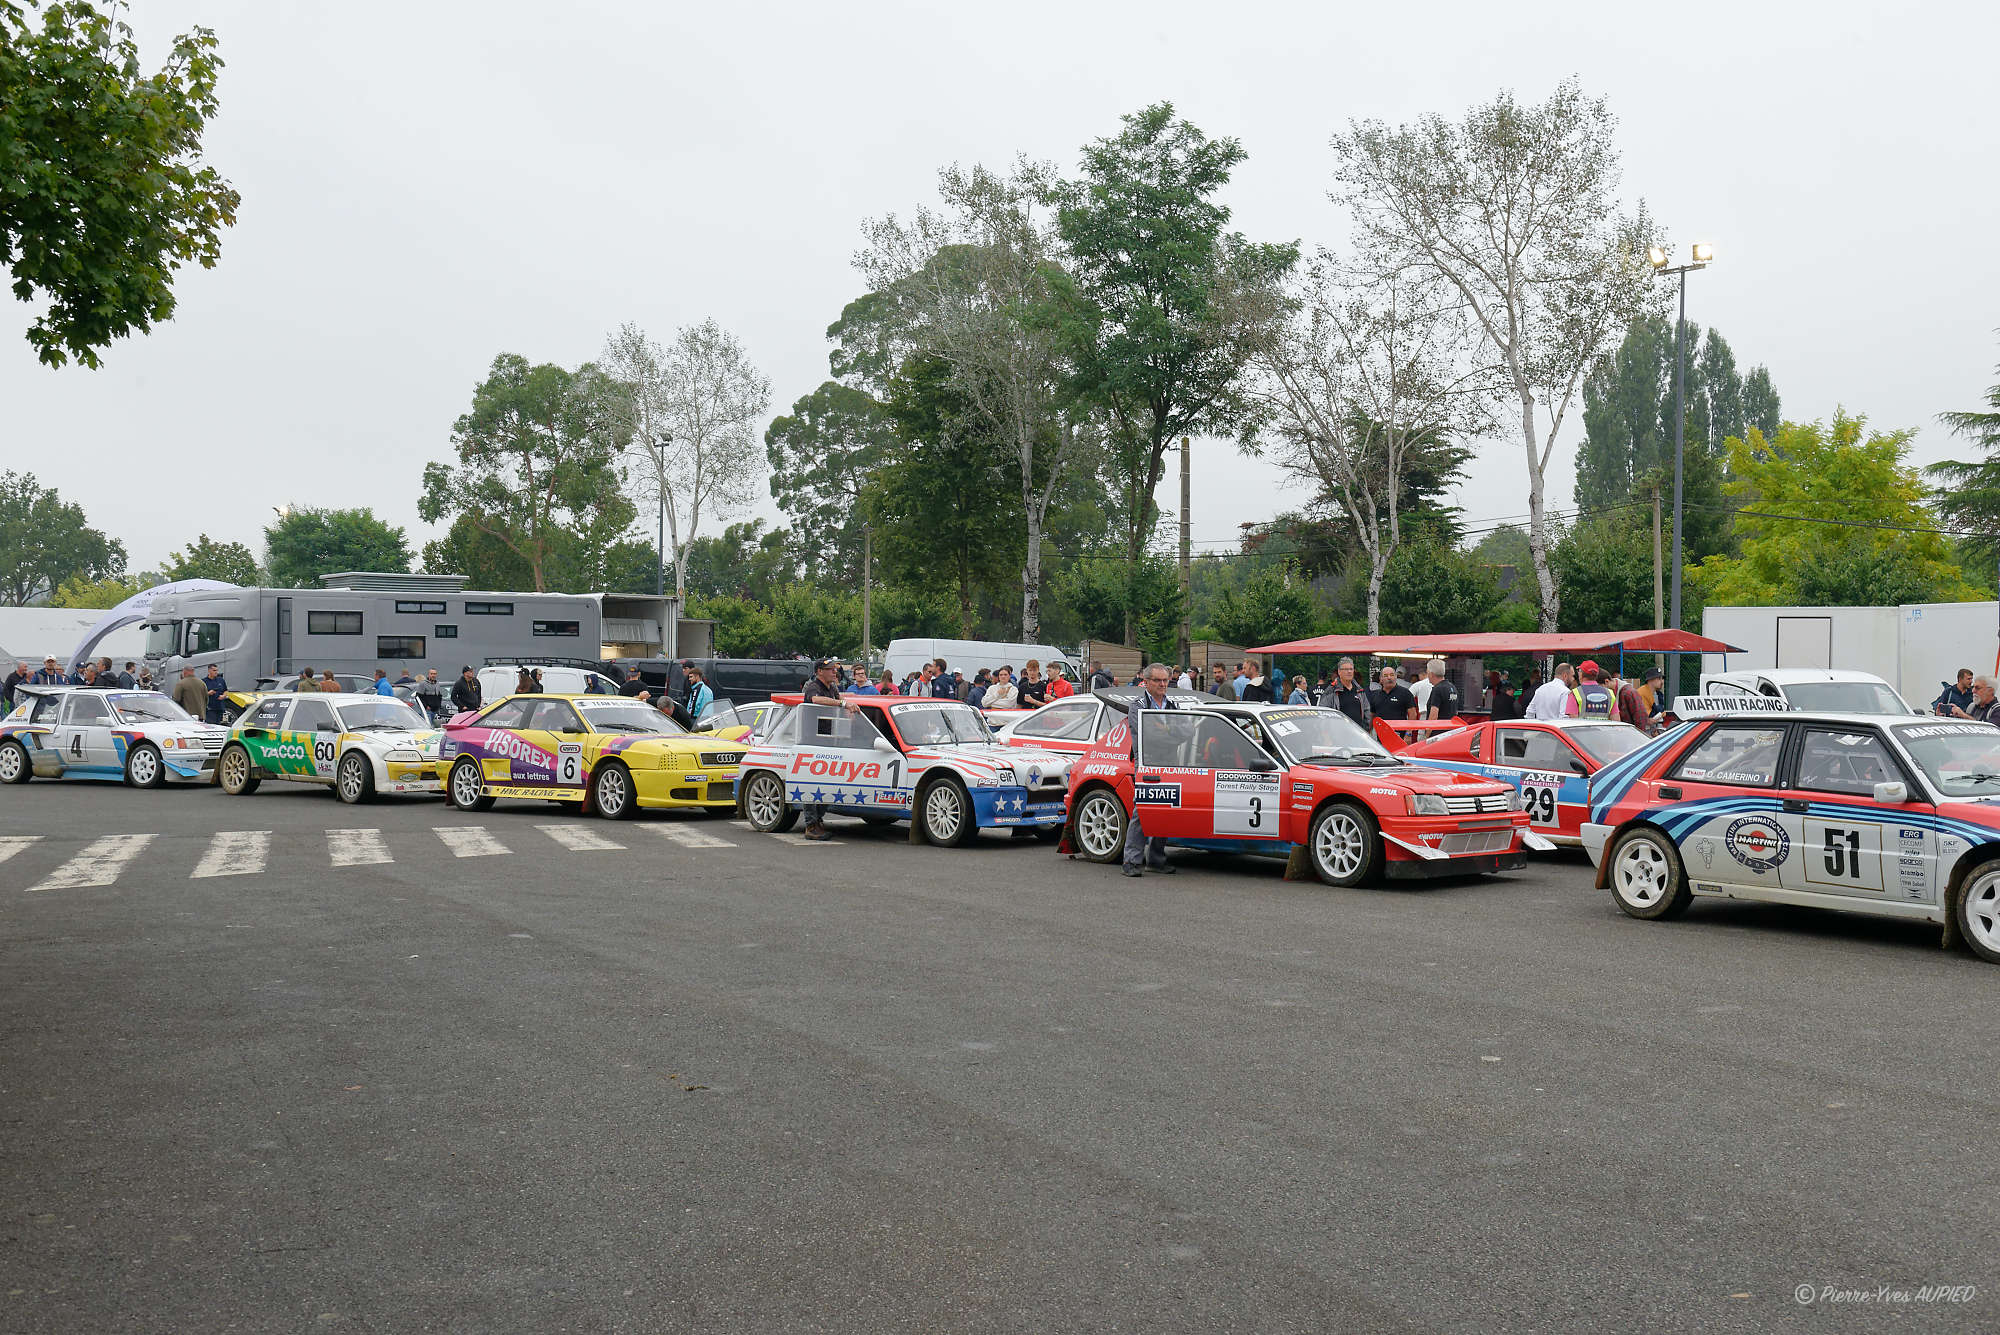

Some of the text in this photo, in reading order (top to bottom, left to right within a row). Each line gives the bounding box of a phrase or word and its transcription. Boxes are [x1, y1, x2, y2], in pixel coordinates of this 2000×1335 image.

[1684, 699, 1783, 712] MARTINI RACING
[753, 710, 763, 726] 7
[1902, 725, 1964, 739] MARTINI
[71, 734, 82, 758] 4
[261, 745, 305, 760] YACCO
[315, 742, 335, 762] 60
[484, 729, 552, 770] VISOREX
[1096, 751, 1129, 761] PIONEER
[563, 757, 575, 780] 6
[791, 753, 881, 783] Fouya
[887, 759, 901, 789] 1
[1083, 764, 1120, 776] MOTUL
[526, 772, 550, 781] lettres
[1000, 771, 1014, 783] elf
[1524, 773, 1561, 784] AXEL
[1716, 771, 1760, 782] CAMERINO
[1239, 783, 1257, 791] Rally
[1258, 784, 1279, 792] Stage
[1523, 780, 1560, 788] FERMETURES
[521, 789, 557, 797] RACING
[1148, 788, 1177, 799] STATE
[1369, 788, 1398, 796] MOTUL
[1523, 786, 1555, 823] 29
[1248, 796, 1263, 828] 3
[1736, 816, 1788, 841] INTERNATIONAL
[1778, 841, 1789, 861] CLUB
[1903, 830, 1920, 838] ERG
[1738, 835, 1777, 847] MARTINI
[1823, 828, 1860, 879] 51
